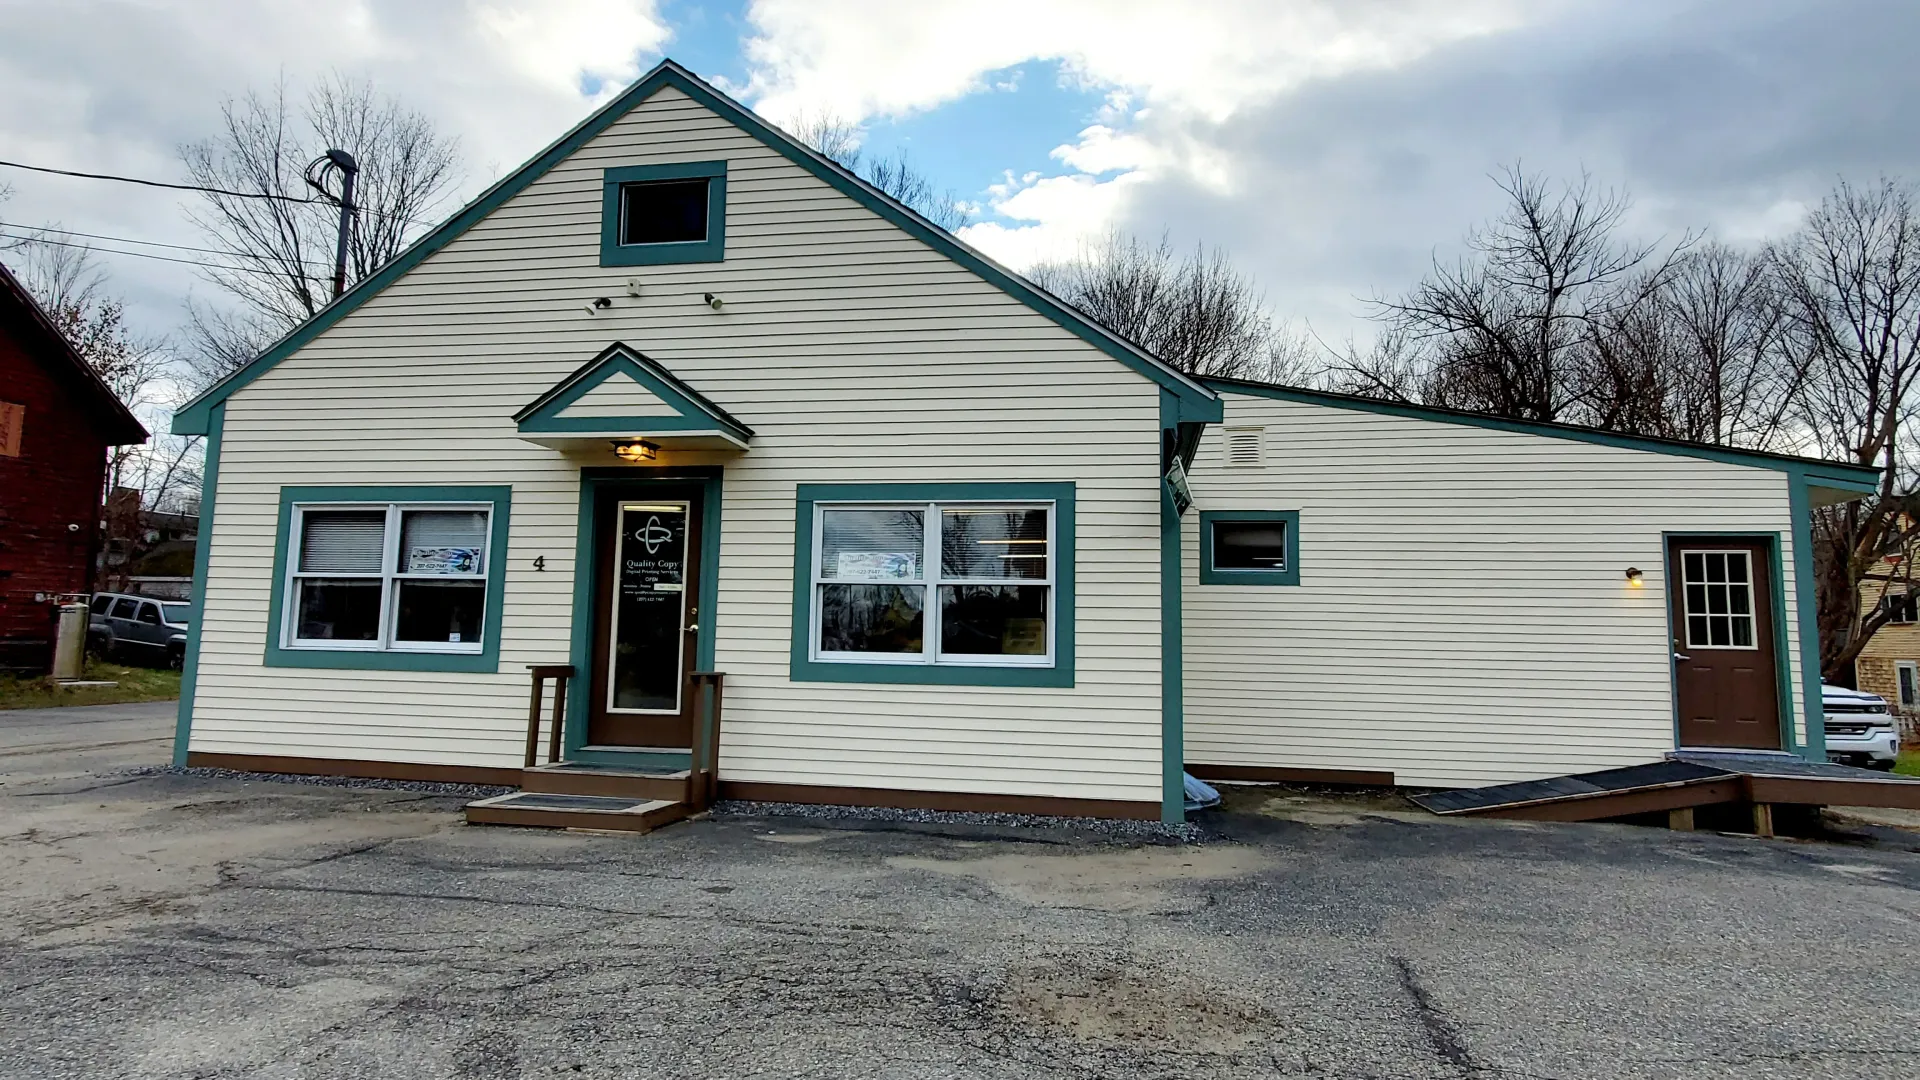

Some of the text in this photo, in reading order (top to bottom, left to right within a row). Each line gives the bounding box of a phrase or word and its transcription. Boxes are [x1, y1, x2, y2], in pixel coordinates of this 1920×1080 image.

[532, 555, 545, 572] 4
[626, 560, 678, 569] Quality Copy
